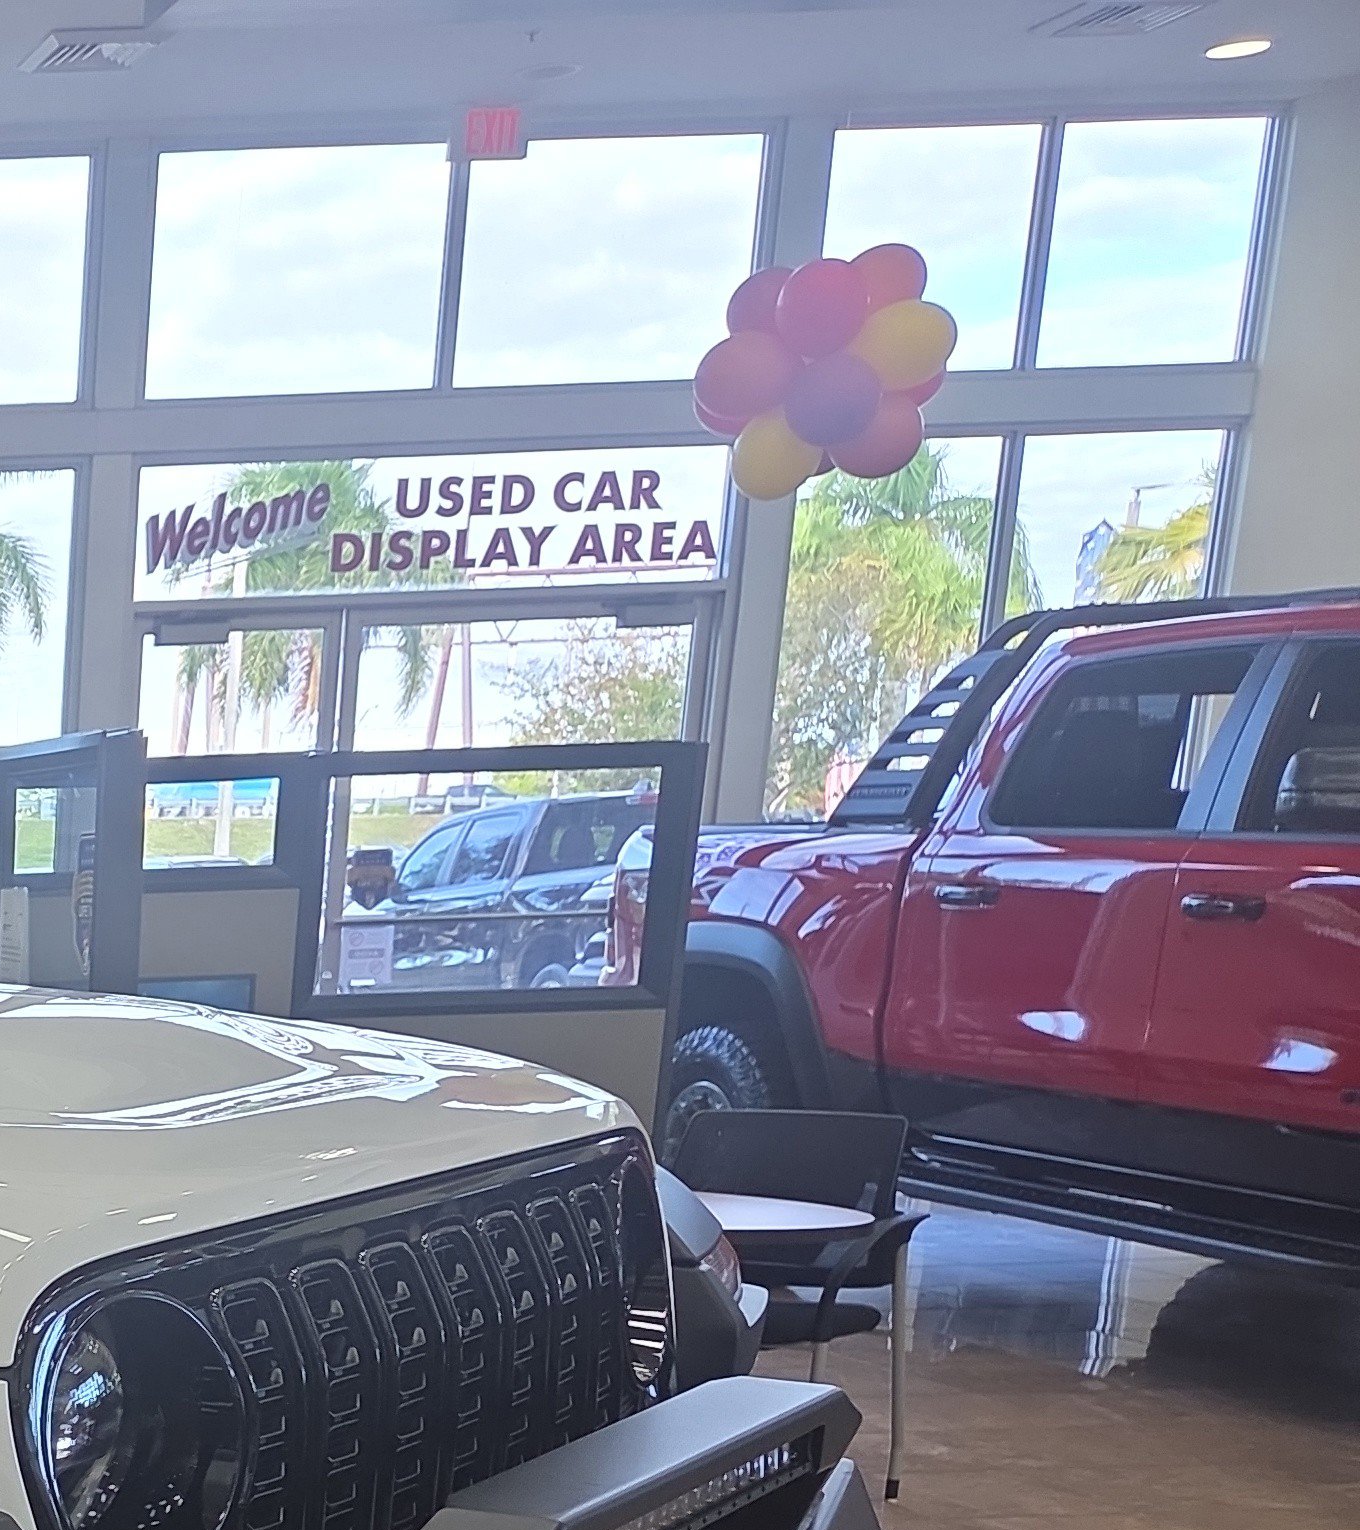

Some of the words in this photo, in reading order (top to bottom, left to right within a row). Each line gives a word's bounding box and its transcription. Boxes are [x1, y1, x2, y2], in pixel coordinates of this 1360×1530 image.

[397, 474, 535, 518] USED
[554, 469, 661, 513] CAR
[144, 481, 331, 575] Welcome
[330, 525, 556, 573] DISPLAY
[566, 520, 718, 565] AREA
